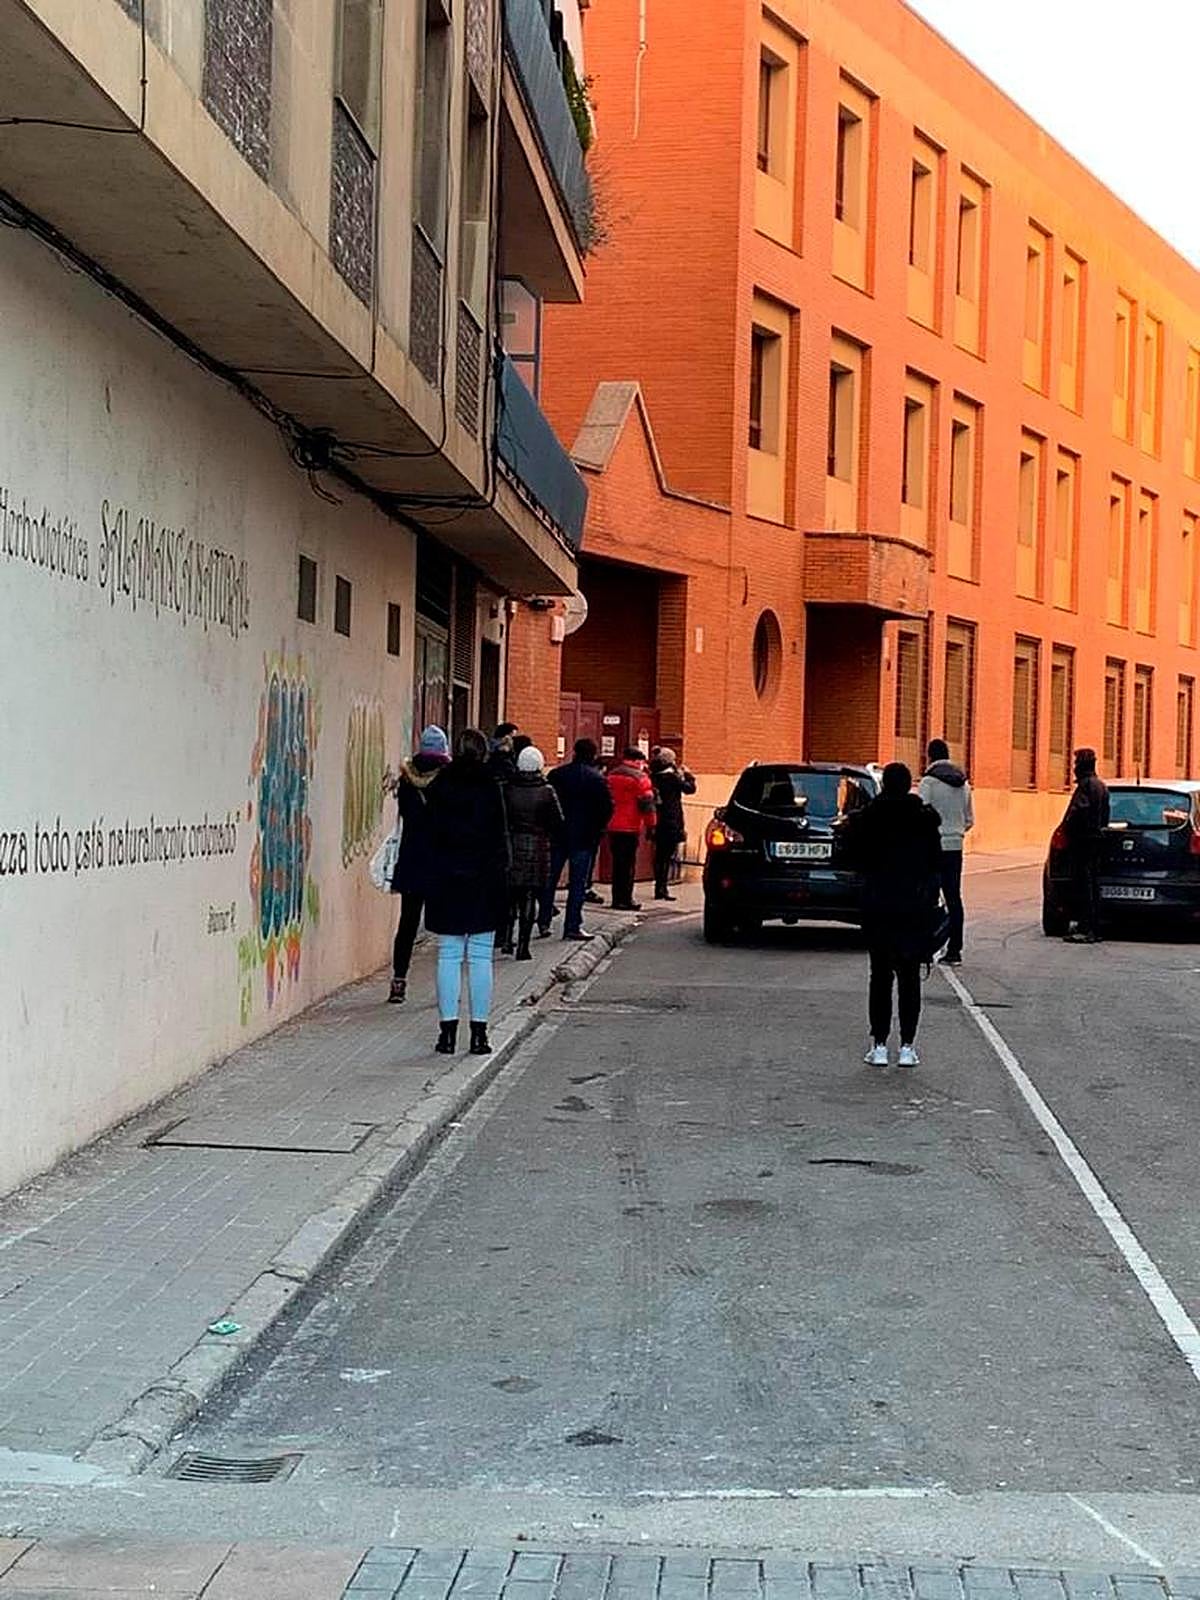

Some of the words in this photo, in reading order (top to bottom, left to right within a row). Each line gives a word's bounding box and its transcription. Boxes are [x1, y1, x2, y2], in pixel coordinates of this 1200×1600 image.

[34, 815, 71, 874] todo
[74, 815, 104, 877] está
[108, 813, 187, 867] naturalmente
